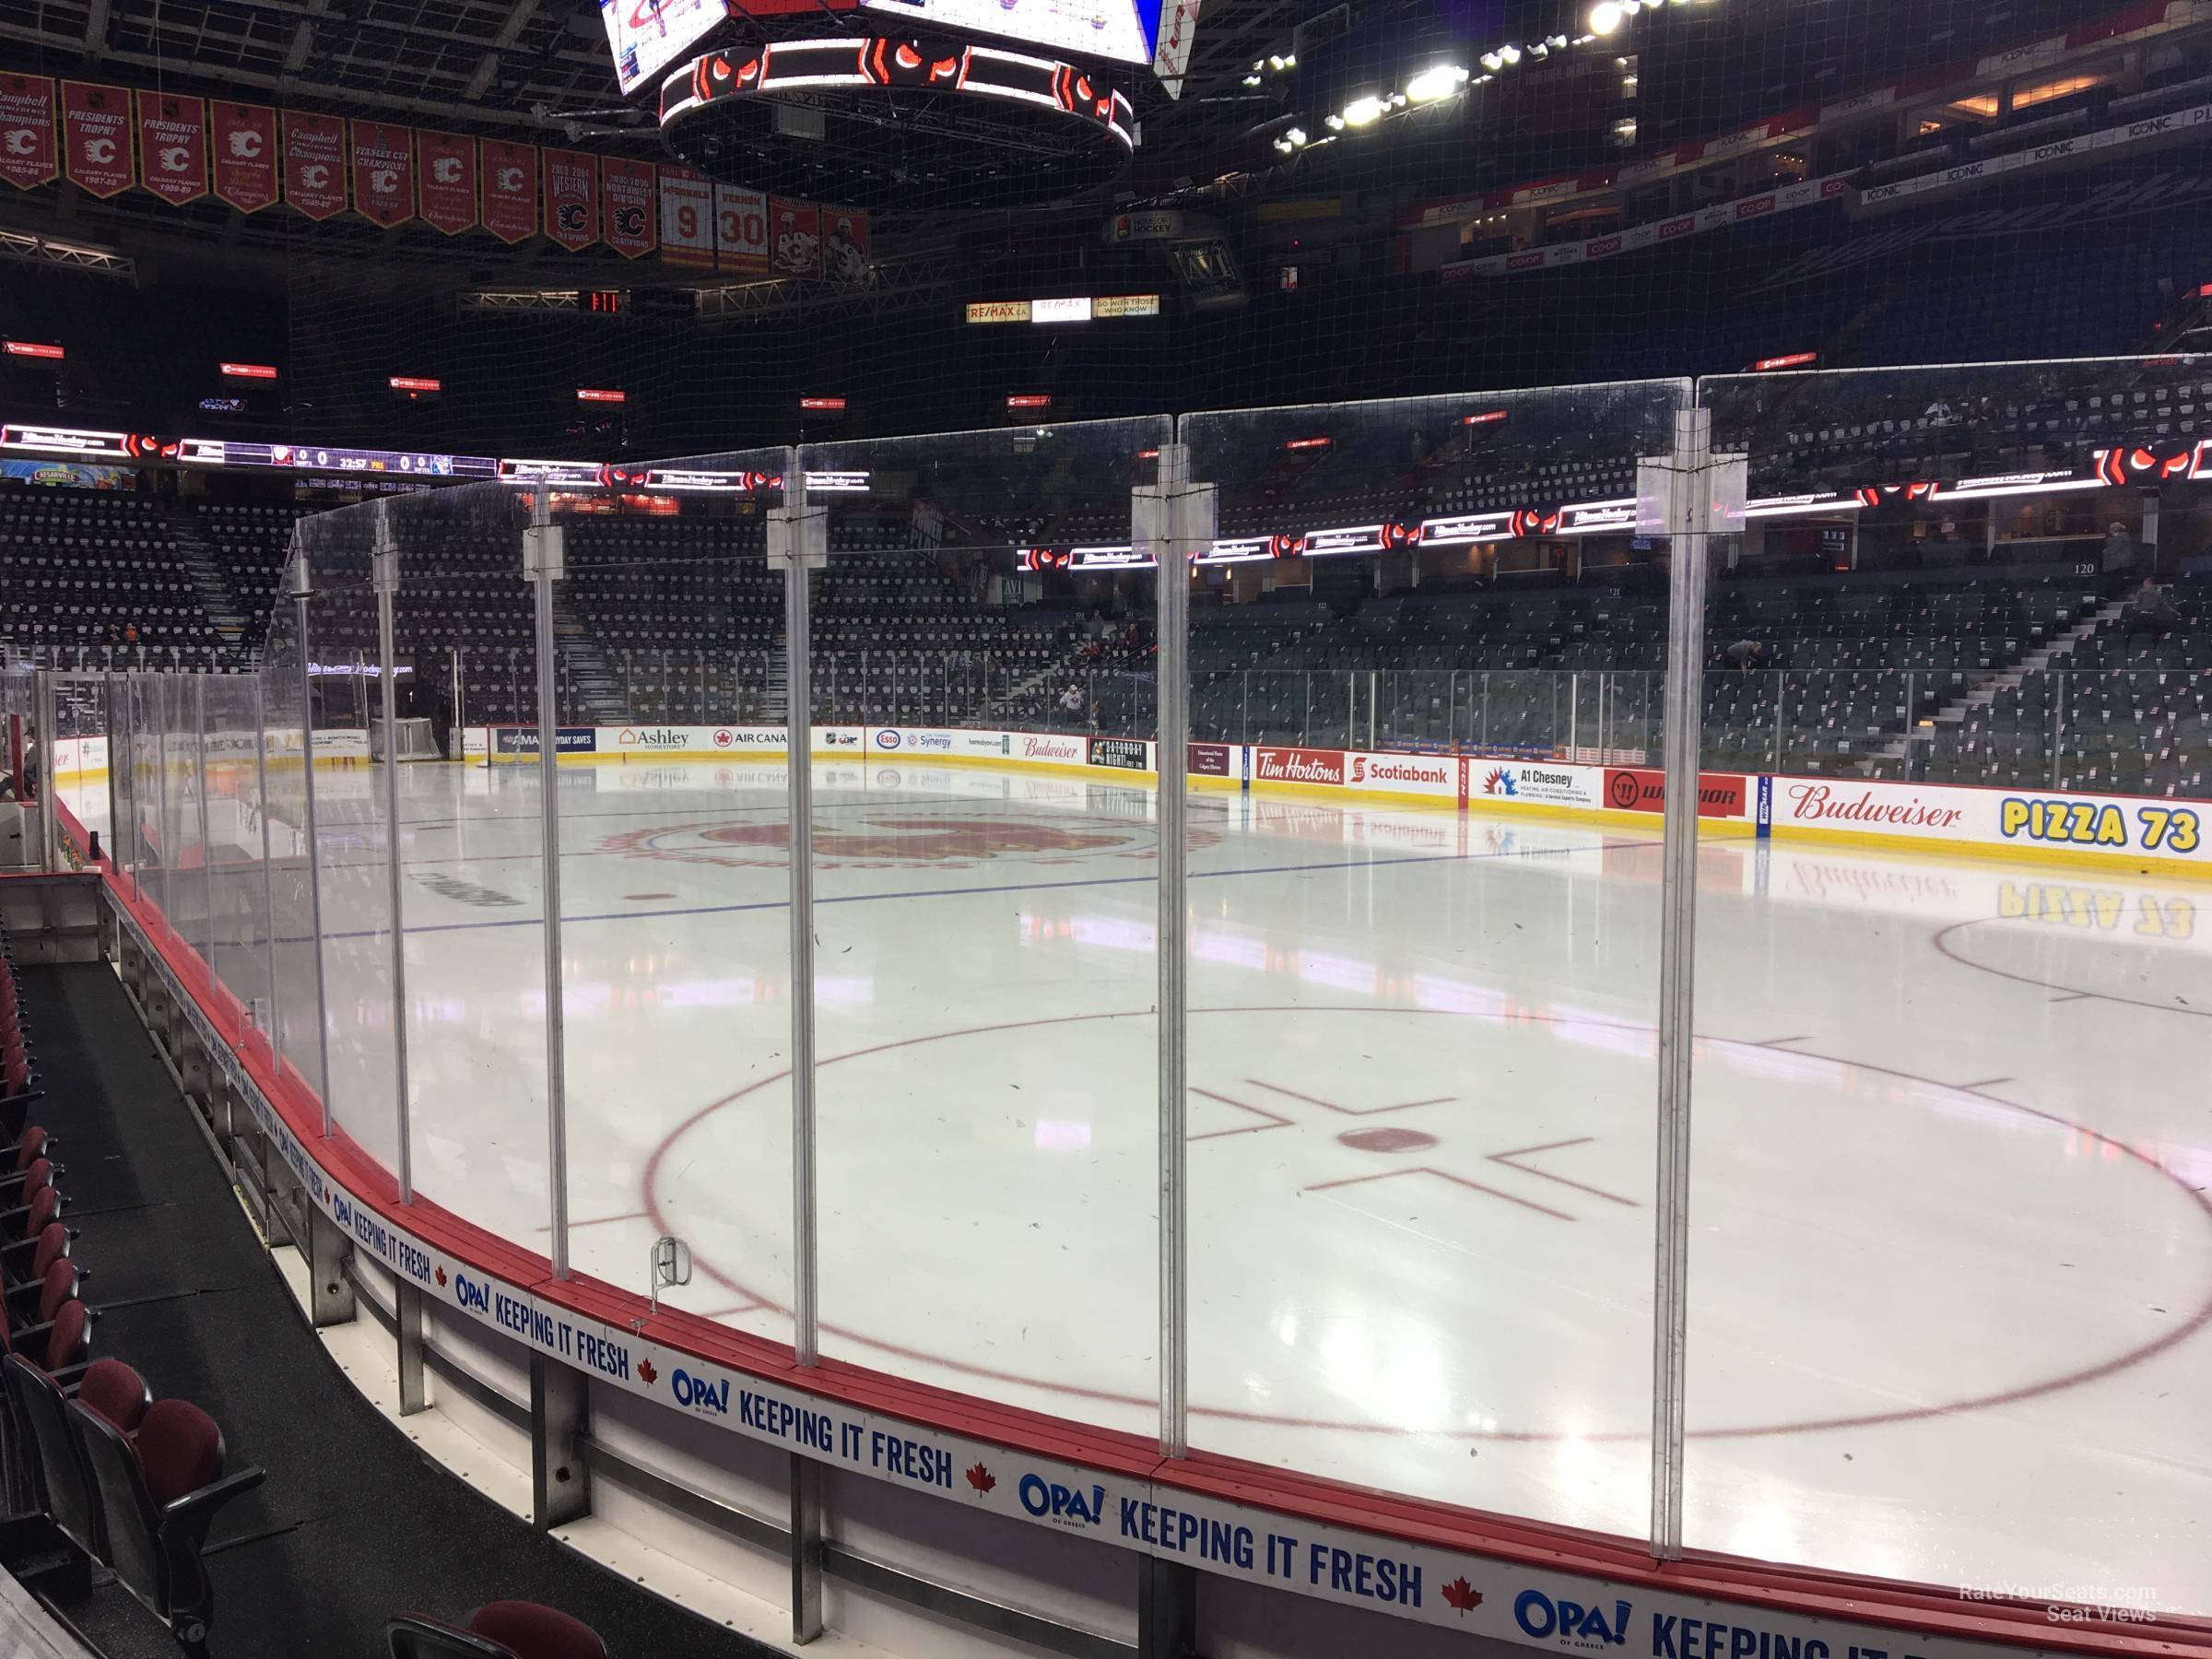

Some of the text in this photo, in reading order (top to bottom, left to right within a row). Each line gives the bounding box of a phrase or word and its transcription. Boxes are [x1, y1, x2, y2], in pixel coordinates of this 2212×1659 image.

[80, 123, 117, 135] TROPHY
[2129, 117, 2171, 136] ICONIC
[155, 132, 191, 144] TROPHY
[290, 128, 338, 143] Campbell
[289, 147, 341, 162] Champions
[356, 147, 392, 159] STANLEY
[2034, 141, 2075, 160] ICONIC
[358, 158, 406, 171] CHAMPIONS
[74, 169, 100, 177] CALGARY
[1947, 163, 1983, 182] ICONIC
[149, 176, 175, 184] CALGARY
[553, 175, 590, 201] WESTERN
[606, 182, 653, 198] NORTHWEST
[1867, 184, 1901, 201] ICONIC
[613, 193, 647, 206] DIVISION
[1740, 199, 1772, 214] CO-OP
[678, 206, 697, 239] 9
[721, 210, 764, 246] 30
[1134, 224, 1171, 233] HOCKEY
[1663, 221, 1690, 235] CO-OP
[611, 236, 649, 249] CHAMPIONS
[1591, 241, 1618, 253] CO-OP
[1510, 255, 1539, 267] CO-OP
[1442, 267, 1469, 279] CO-OP
[1131, 298, 1155, 306] THOSE
[971, 307, 1014, 318] RE/MAX
[1124, 306, 1147, 314] KNOW
[300, 449, 307, 460] 0
[317, 451, 410, 470] 0 32:57 PRE 0
[418, 456, 426, 467] 0
[910, 527, 940, 559] PLAY
[2075, 563, 2094, 574] 120
[512, 735, 539, 745] AMA
[572, 735, 591, 745] SAVES
[637, 729, 688, 747] Ashley
[735, 734, 787, 743] AIR CANA
[880, 735, 897, 744] Esso
[920, 735, 951, 748] Synergy
[1023, 736, 1077, 759] Budweiser
[1106, 741, 1143, 756] SATURDAY
[1107, 753, 1126, 767] NIGHT!
[1259, 752, 1283, 777] Tim
[1284, 753, 1341, 782] Hortons
[1371, 764, 1447, 784] Scotiabank
[1521, 770, 1572, 788] A1 Chesney
[1759, 785, 1769, 820] WINMAR
[1789, 784, 1961, 830] Budweiser
[2000, 797, 2201, 853] PIZZA 73
[334, 1193, 430, 1284] OPA! KEEPING IT FRESH
[455, 1274, 629, 1381] OPA! KEEPING IT FRESH
[671, 1369, 953, 1489] OPA! KEEPING IT FRESH
[1063, 1521, 1085, 1529] GREECE
[1018, 1473, 1422, 1607] OPA! KEEPING IT FRESH
[1513, 1588, 1632, 1646] OPA!
[1559, 1638, 1605, 1650] OF GREECE
